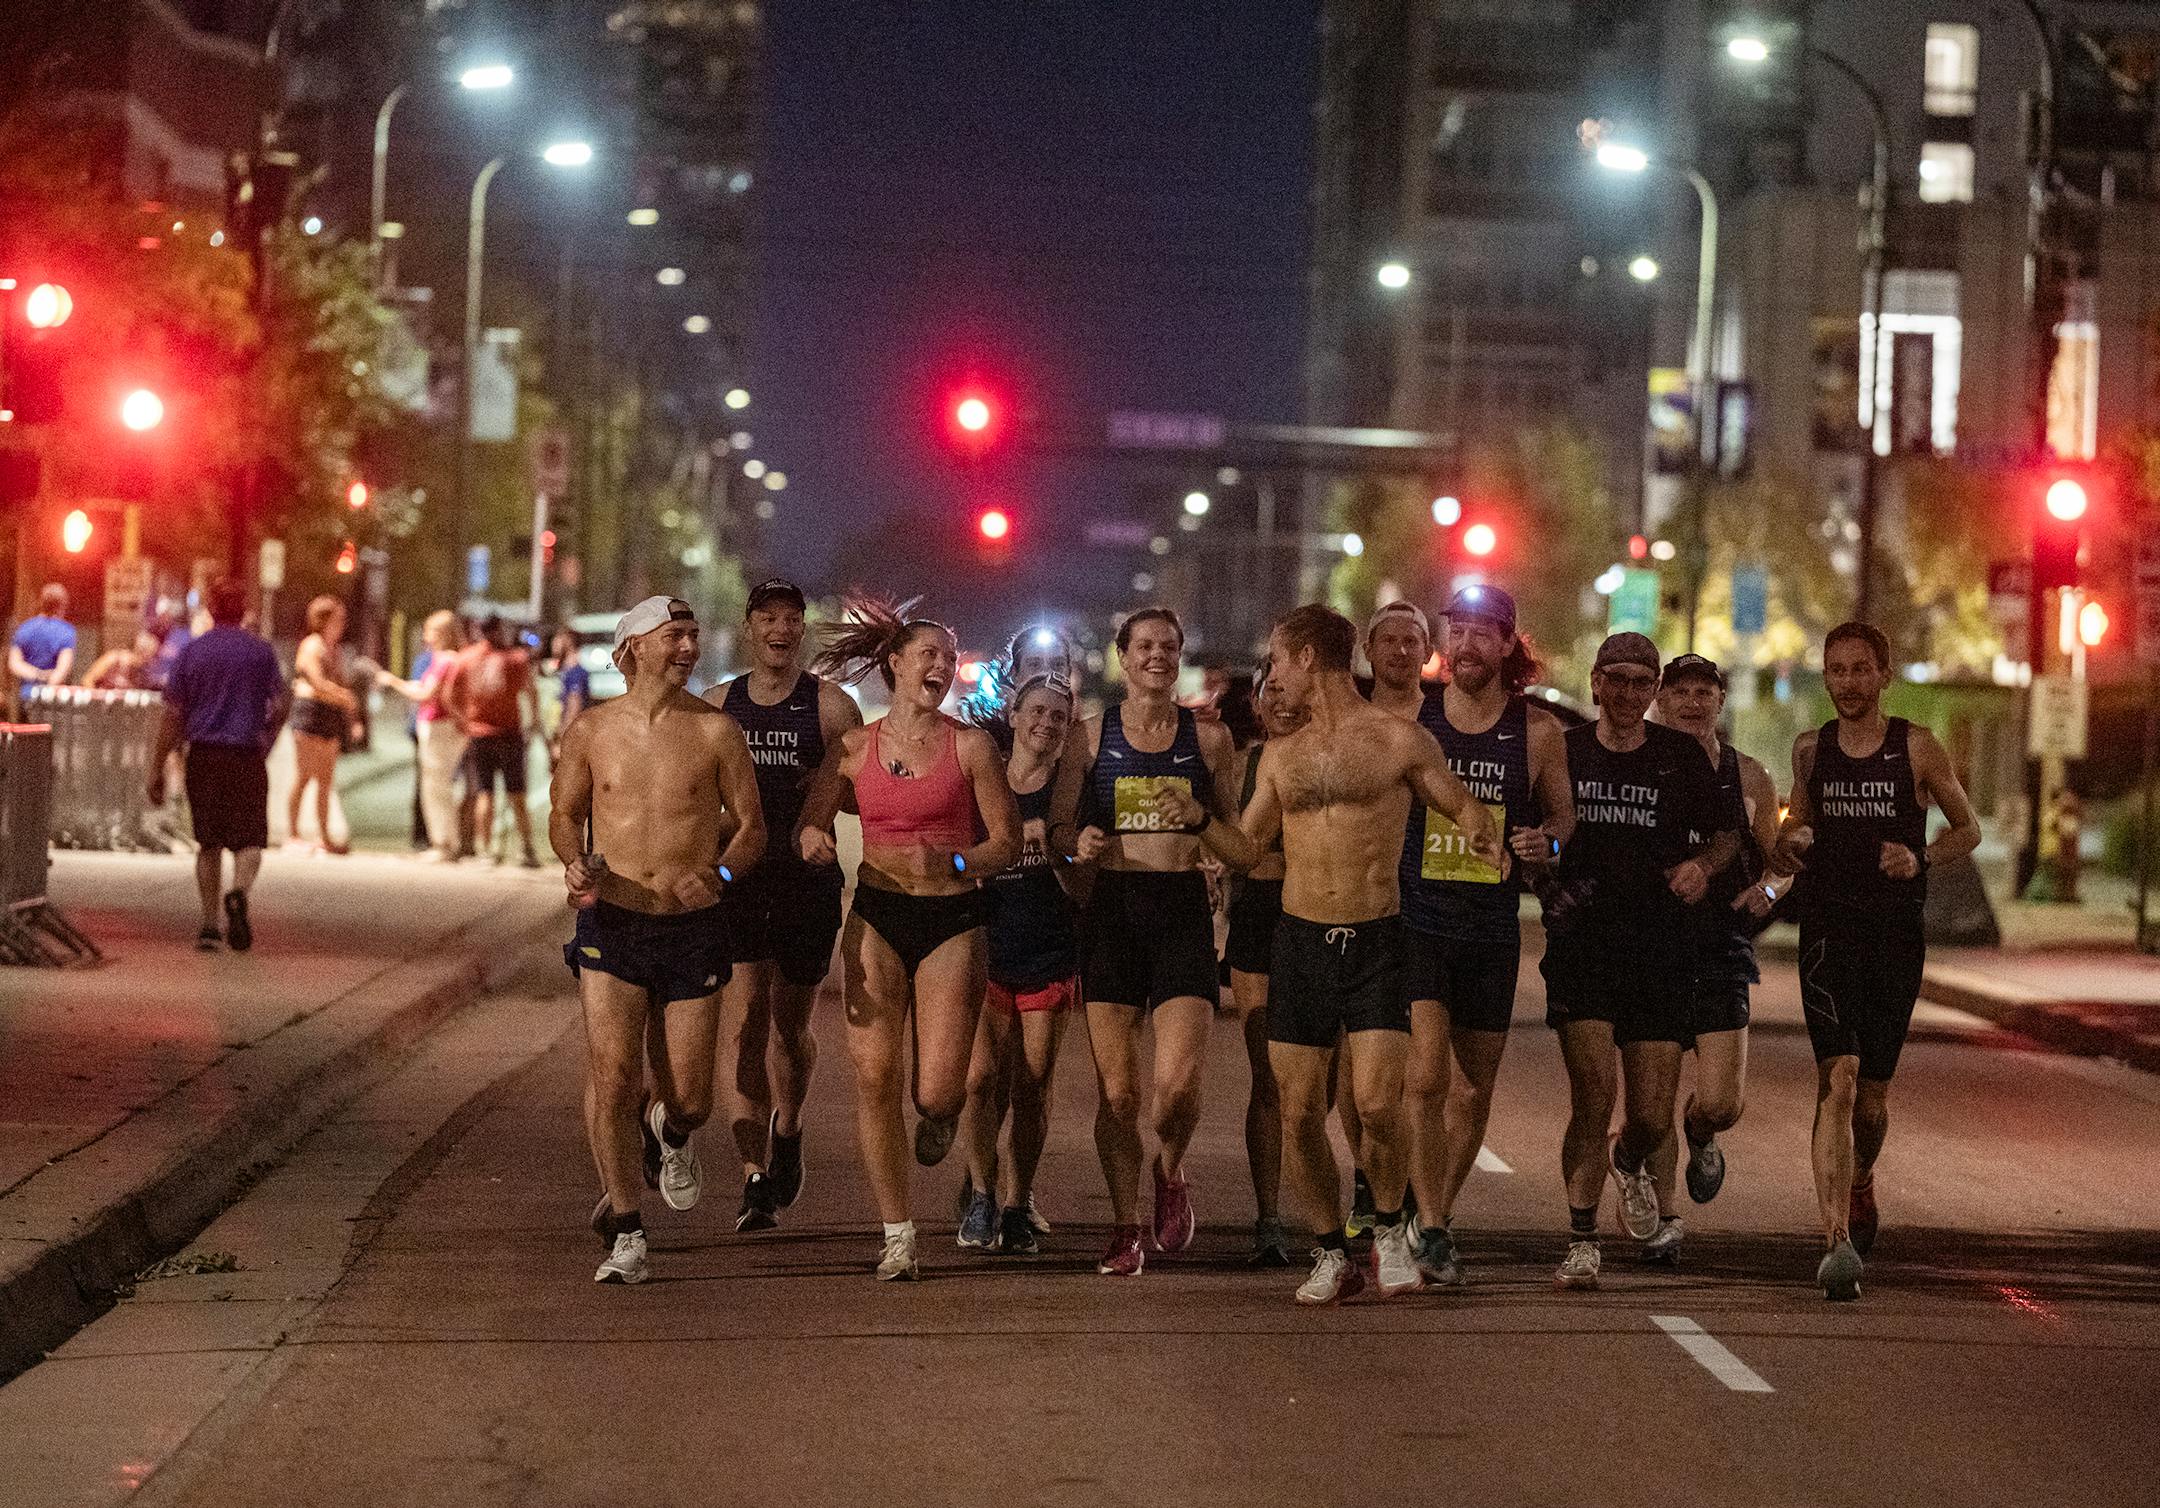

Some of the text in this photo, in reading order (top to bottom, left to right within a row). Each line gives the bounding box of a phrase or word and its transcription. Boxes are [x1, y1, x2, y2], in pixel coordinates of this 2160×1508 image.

[743, 731, 799, 748] LL CITY
[750, 749, 800, 767] NNING
[1469, 760, 1506, 781] CITY
[1577, 780, 1659, 806] MILL CITY
[1822, 781, 1895, 799] MILL CITY
[1576, 803, 1657, 828] RUNNING
[1822, 800, 1897, 818] RUNNING
